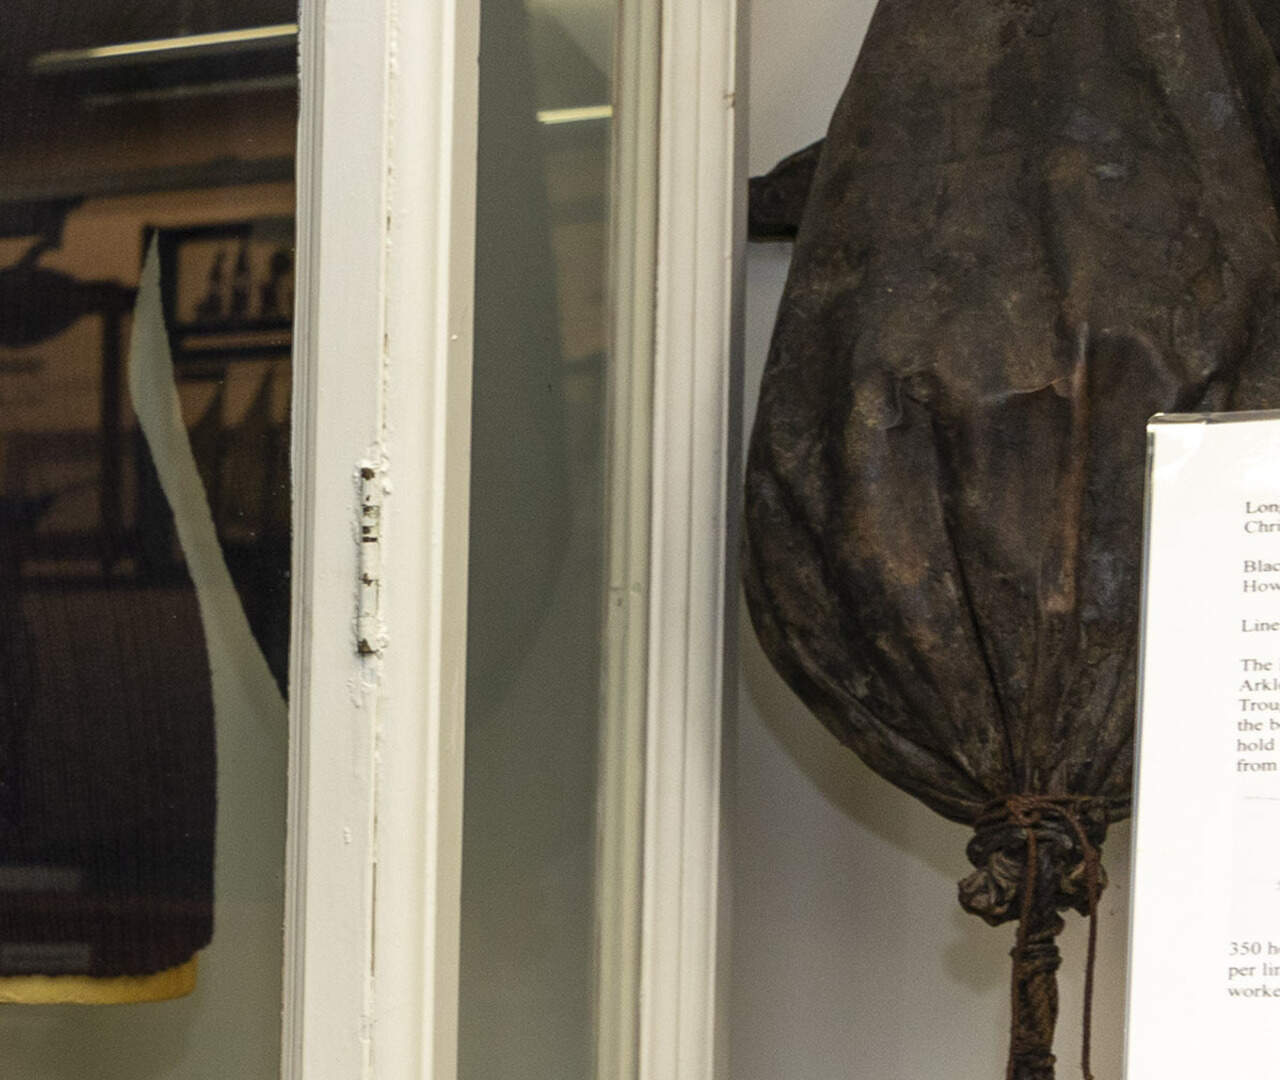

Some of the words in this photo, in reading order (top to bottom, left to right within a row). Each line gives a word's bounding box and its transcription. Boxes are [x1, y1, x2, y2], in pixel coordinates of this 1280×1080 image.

[1240, 658, 1272, 671] The
[1238, 698, 1280, 712] Trou
[1238, 718, 1264, 731] the
[1237, 738, 1276, 751] hold
[1237, 758, 1278, 772] from
[1228, 941, 1262, 956] 350
[1228, 966, 1256, 980] per
